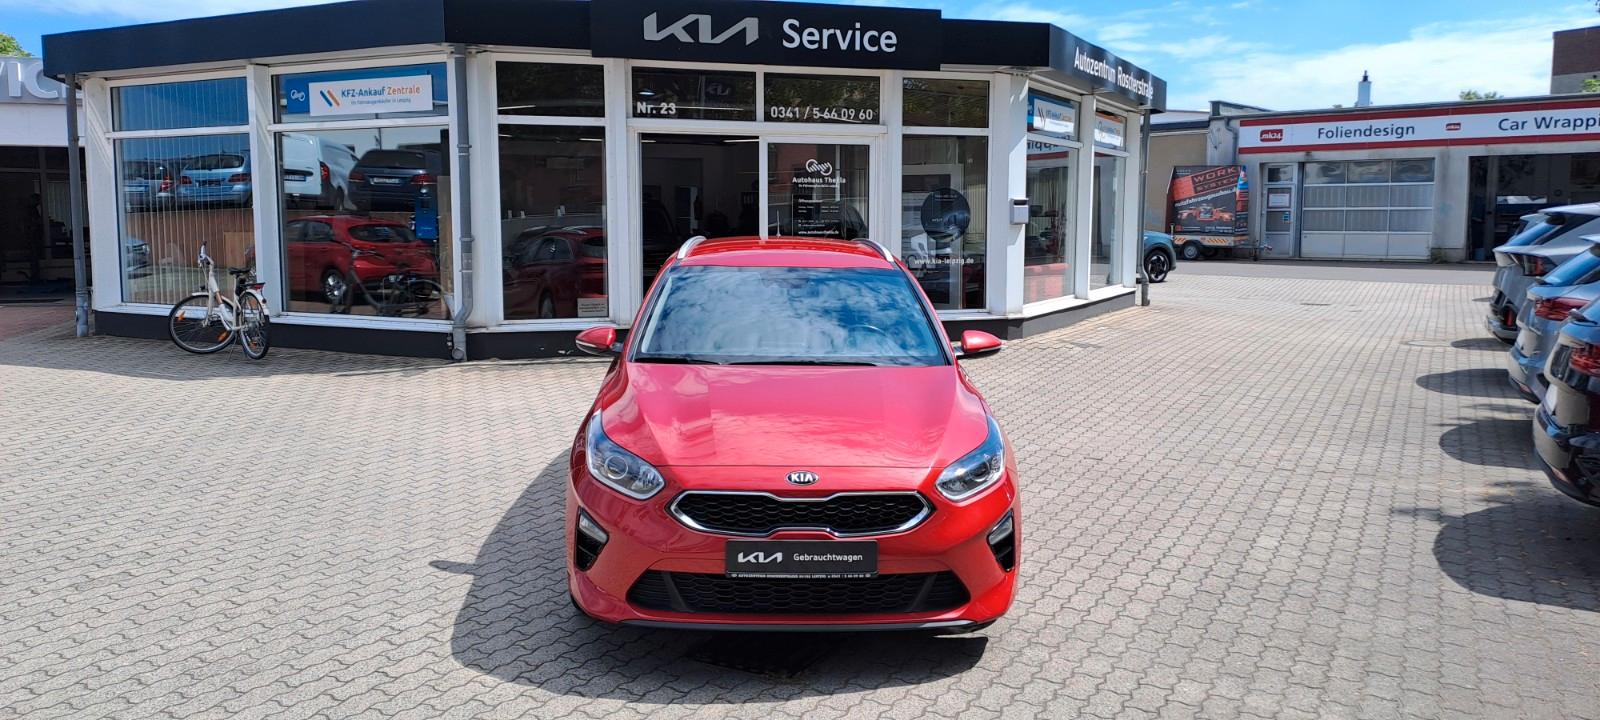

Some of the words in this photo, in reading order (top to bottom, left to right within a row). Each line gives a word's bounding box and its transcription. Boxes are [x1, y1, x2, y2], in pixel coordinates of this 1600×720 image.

[643, 11, 759, 46] KIA
[782, 18, 898, 53] Service
[1073, 46, 1116, 84] Autozentrum
[341, 86, 385, 98] KFZ-Ankauf
[387, 85, 420, 96] Zentrale
[636, 102, 656, 114] Nr.
[659, 102, 676, 115] 23
[770, 106, 800, 118] 0341
[841, 108, 855, 120] 09
[858, 109, 873, 121] 60
[1317, 123, 1415, 139] Foliendesign
[1498, 118, 1528, 131] Car
[790, 472, 814, 483] KIA
[737, 551, 783, 564] KIA
[793, 553, 863, 563] Gebrauchtwagen
